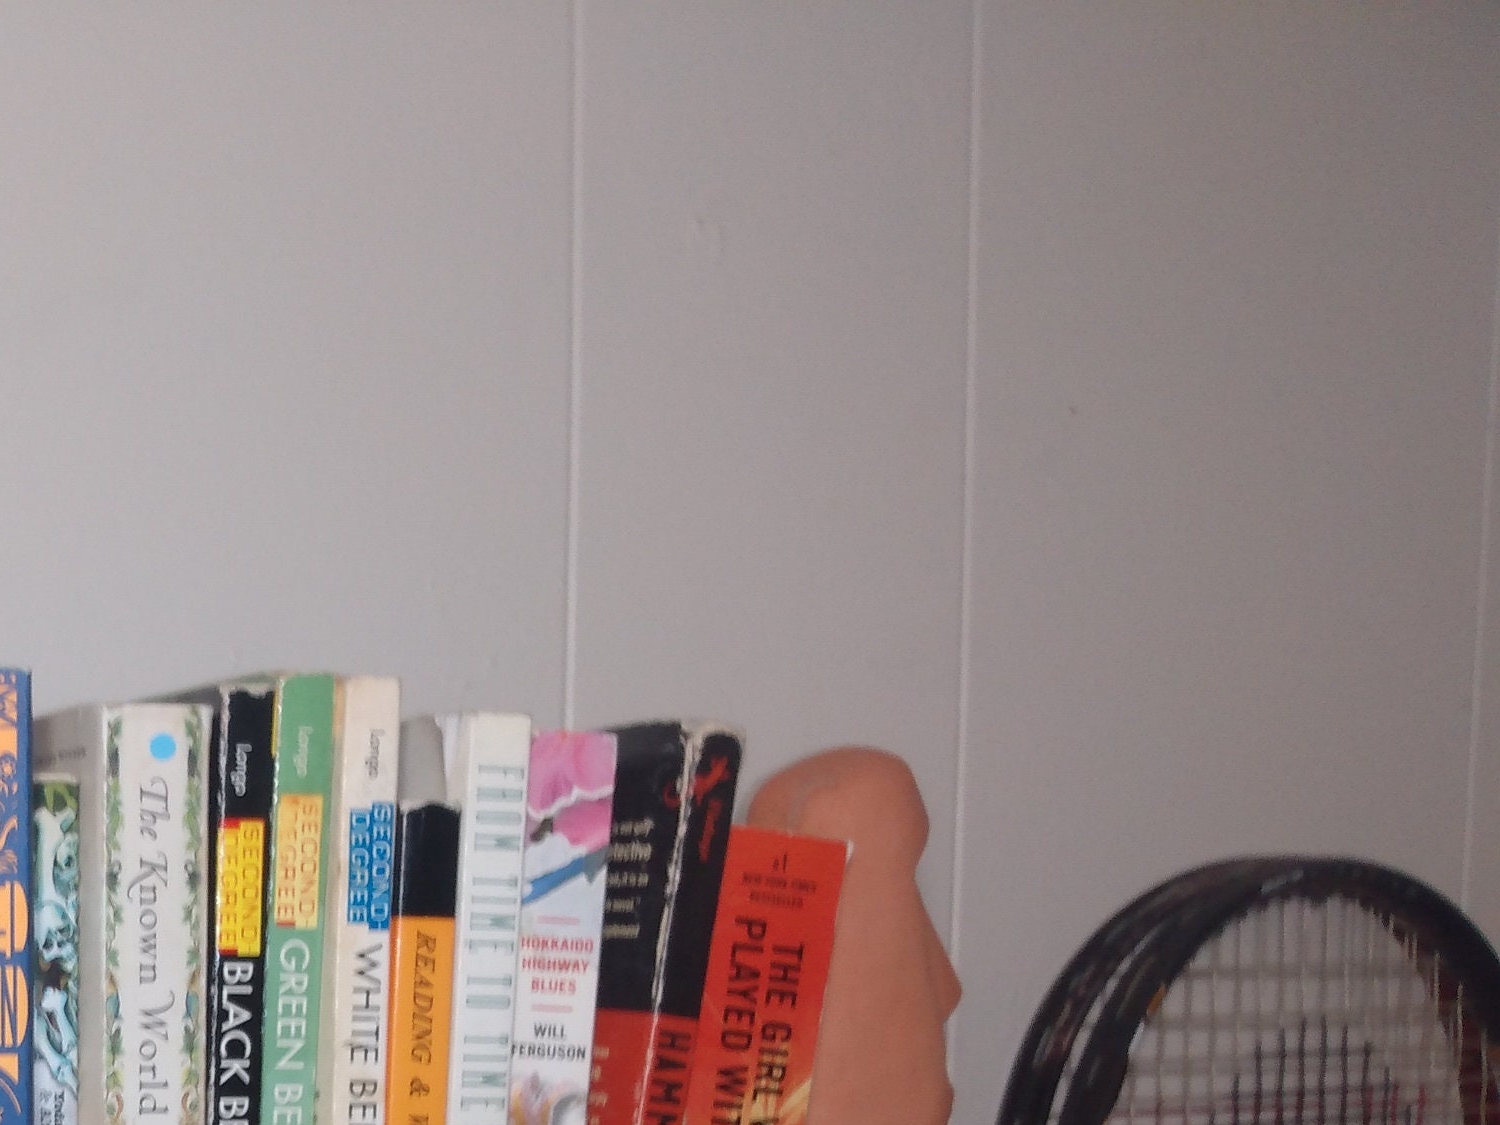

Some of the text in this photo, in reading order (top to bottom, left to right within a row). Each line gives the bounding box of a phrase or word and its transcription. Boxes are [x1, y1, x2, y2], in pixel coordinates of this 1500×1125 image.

[231, 743, 252, 797] Longo
[350, 813, 370, 923] DEGREE
[127, 775, 175, 1117] The Known World
[459, 764, 526, 1111] FROM TIME TO TIME
[521, 936, 594, 954] HOKKAIDO
[522, 955, 589, 975] HIGHWAY
[765, 942, 805, 1008] THE
[219, 960, 254, 1086] BLACK
[273, 937, 311, 1072] GREEN
[348, 943, 383, 1064] WHITE
[410, 929, 438, 1067] READING
[531, 976, 576, 995] BLUES
[719, 914, 768, 1051] PLAYED
[511, 1042, 586, 1061] FERGUSON
[534, 1022, 567, 1039] WILL
[751, 1018, 793, 1105] GIRL
[408, 1077, 432, 1098] &
